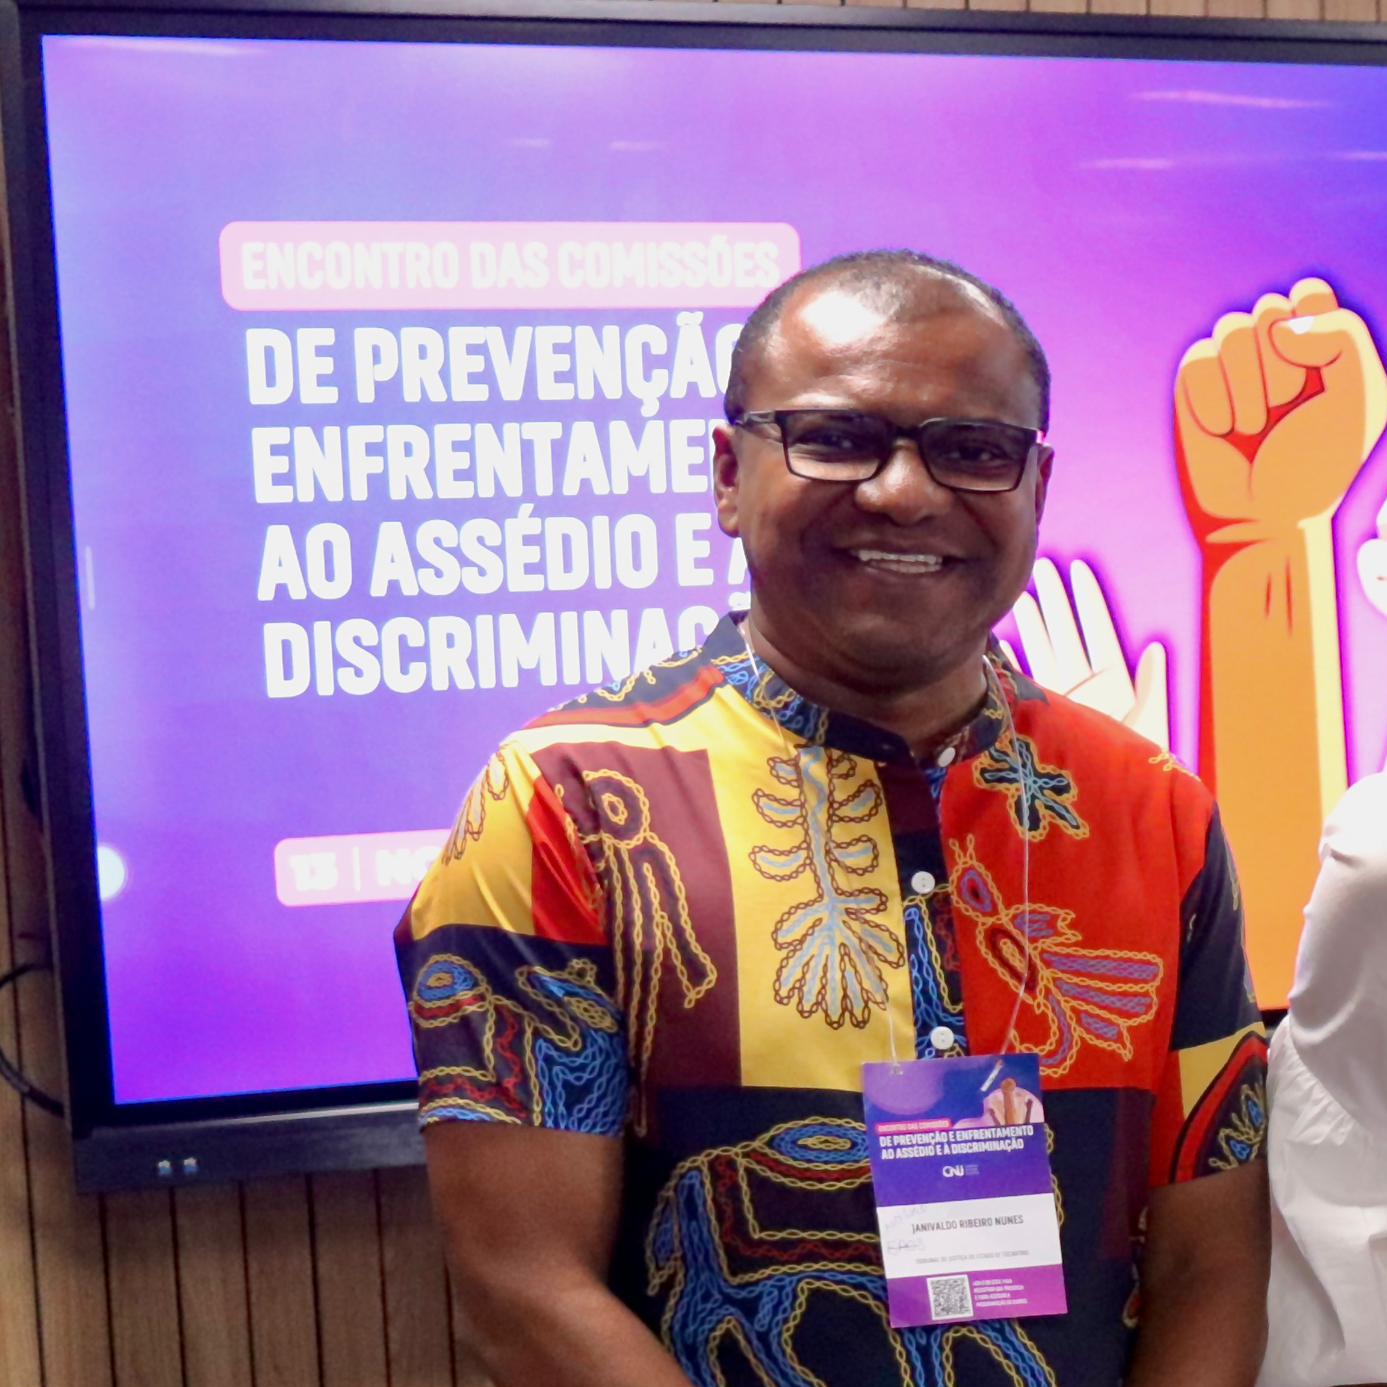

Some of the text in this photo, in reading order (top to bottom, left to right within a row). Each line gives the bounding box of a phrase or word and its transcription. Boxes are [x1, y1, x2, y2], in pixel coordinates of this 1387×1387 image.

[241, 233, 780, 290] ENCONTRO DAS COMISSÕES
[245, 328, 337, 405] DE
[252, 418, 727, 504] ENFRENTAME
[257, 522, 353, 601] AO
[370, 504, 659, 598] ASSÉDIO
[675, 512, 714, 588] E
[263, 594, 748, 698] DISCRIMINA
[880, 1136, 891, 1147] DE
[893, 1128, 948, 1146] PREVENÇÃO
[949, 1131, 955, 1142] E
[956, 1125, 1034, 1141] ENFRENTAMENTO
[881, 1148, 894, 1160] AO
[896, 1143, 934, 1159] ASSÉDIO
[936, 1145, 942, 1156] E
[952, 1136, 1024, 1153] DISCRIMINAÇÃO
[959, 1217, 993, 1229] RIBEIRO
[994, 1215, 1024, 1226] NUNES
